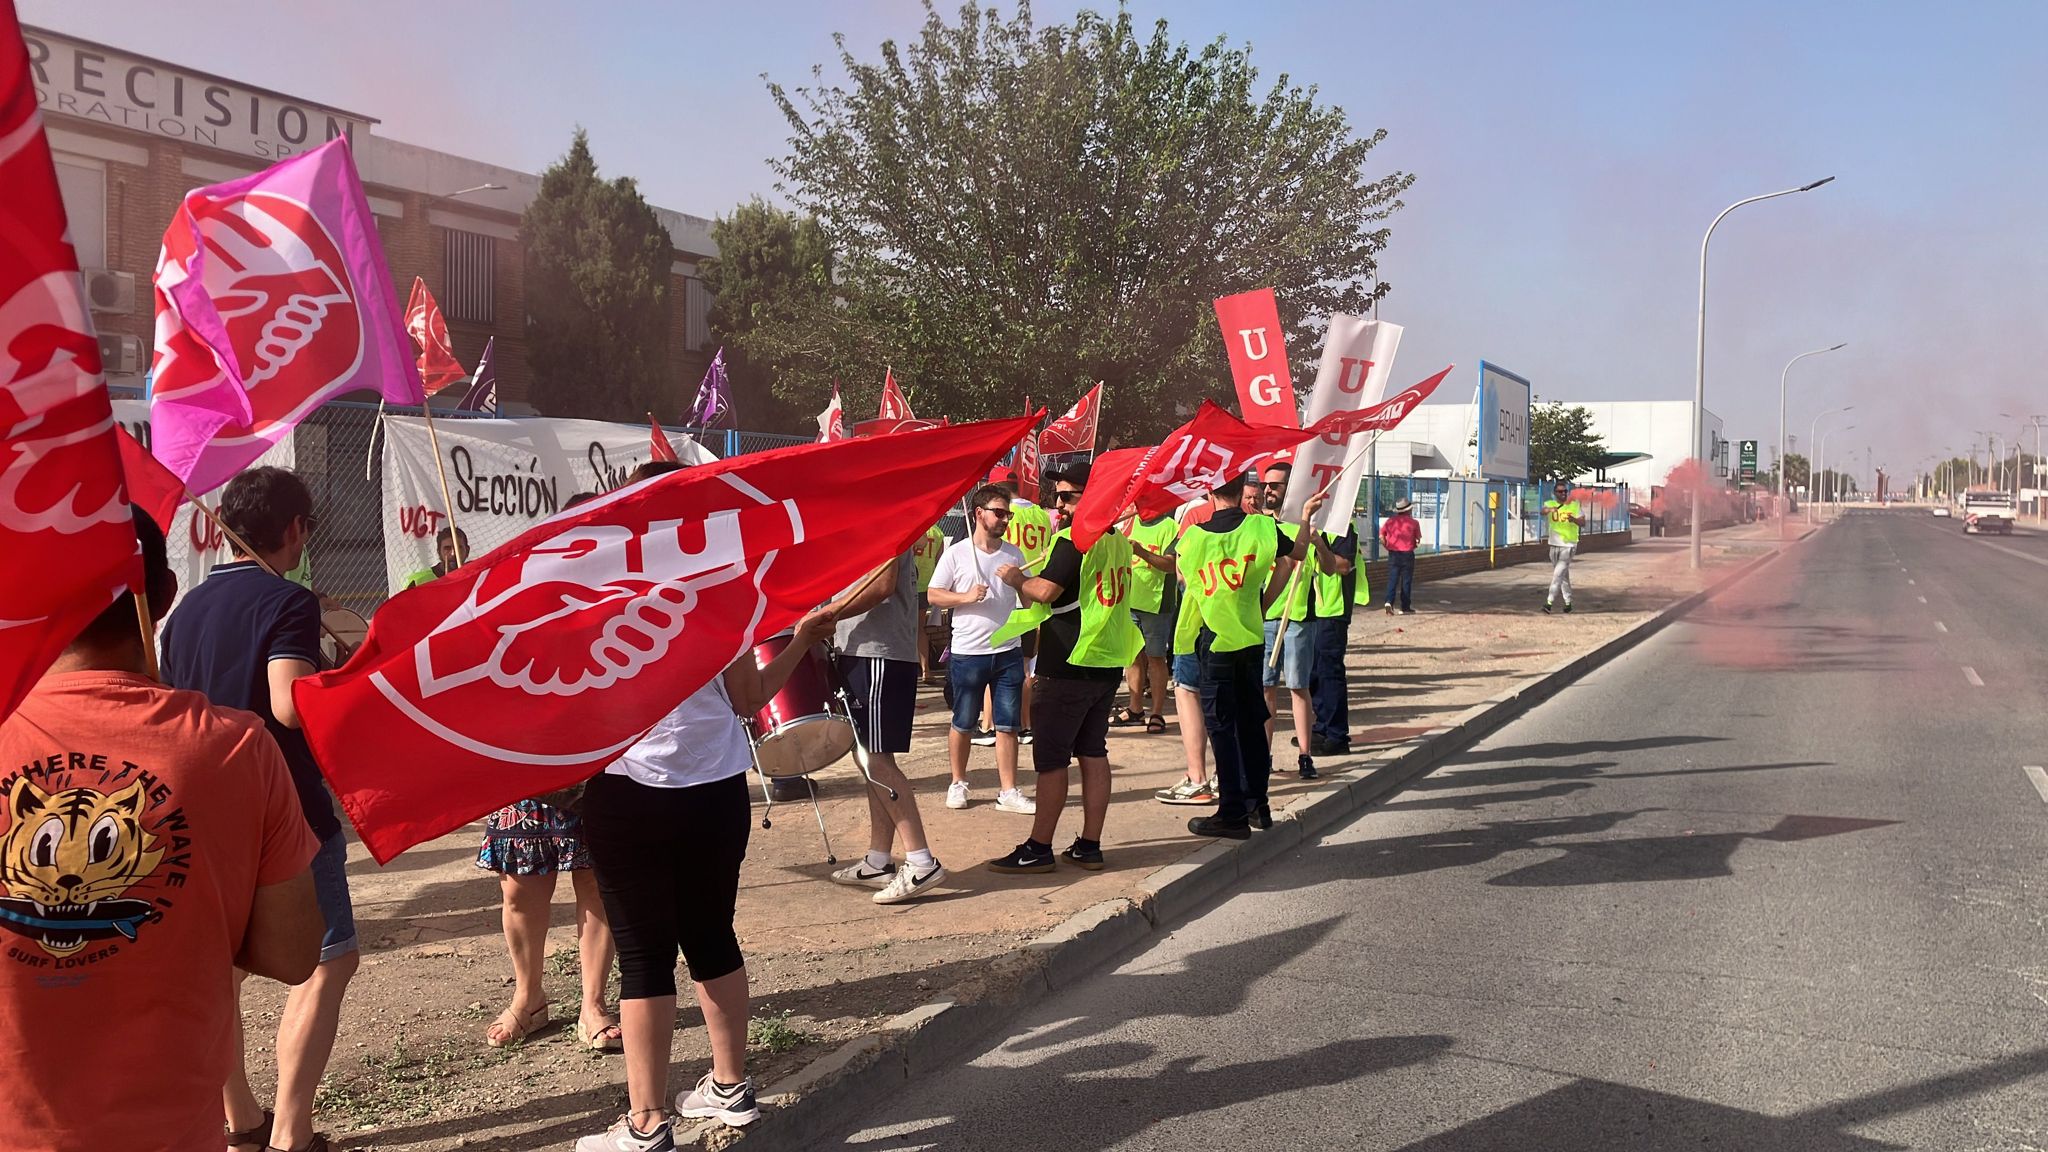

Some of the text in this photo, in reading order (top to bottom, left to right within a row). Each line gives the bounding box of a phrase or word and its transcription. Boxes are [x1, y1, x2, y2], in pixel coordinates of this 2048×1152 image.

[1198, 554, 1256, 597] UGT
[163, 807, 192, 889] WAVE
[8, 944, 120, 970] SURF LOVERS
